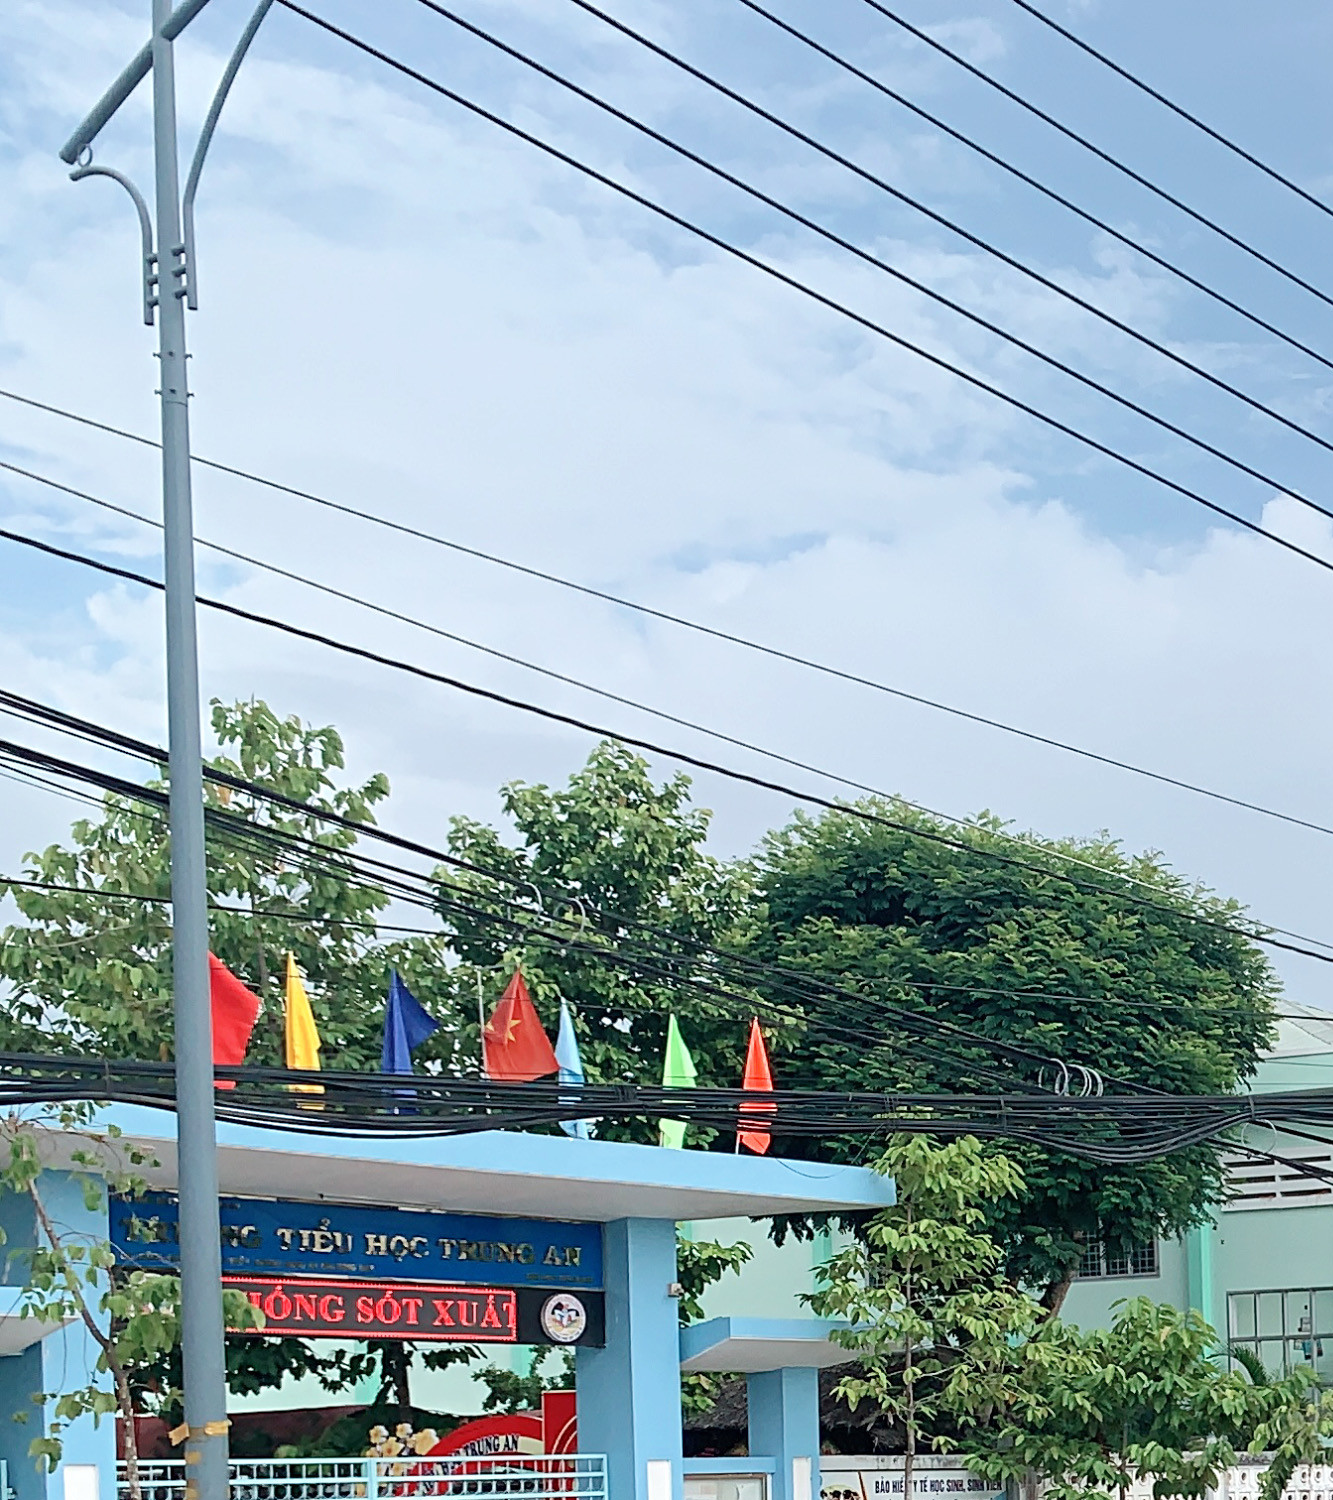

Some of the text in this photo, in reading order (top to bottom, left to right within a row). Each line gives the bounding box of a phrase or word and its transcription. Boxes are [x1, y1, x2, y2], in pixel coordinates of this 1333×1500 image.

[277, 1217, 353, 1255] TIỂU
[364, 1233, 430, 1262] HỌC
[439, 1238, 536, 1264] TRUNG
[542, 1245, 583, 1267] AN
[246, 1284, 346, 1323] HỐNG
[356, 1290, 423, 1325] SỐT
[875, 1475, 890, 1494] BẢO
[891, 1474, 906, 1493] HIỂ
